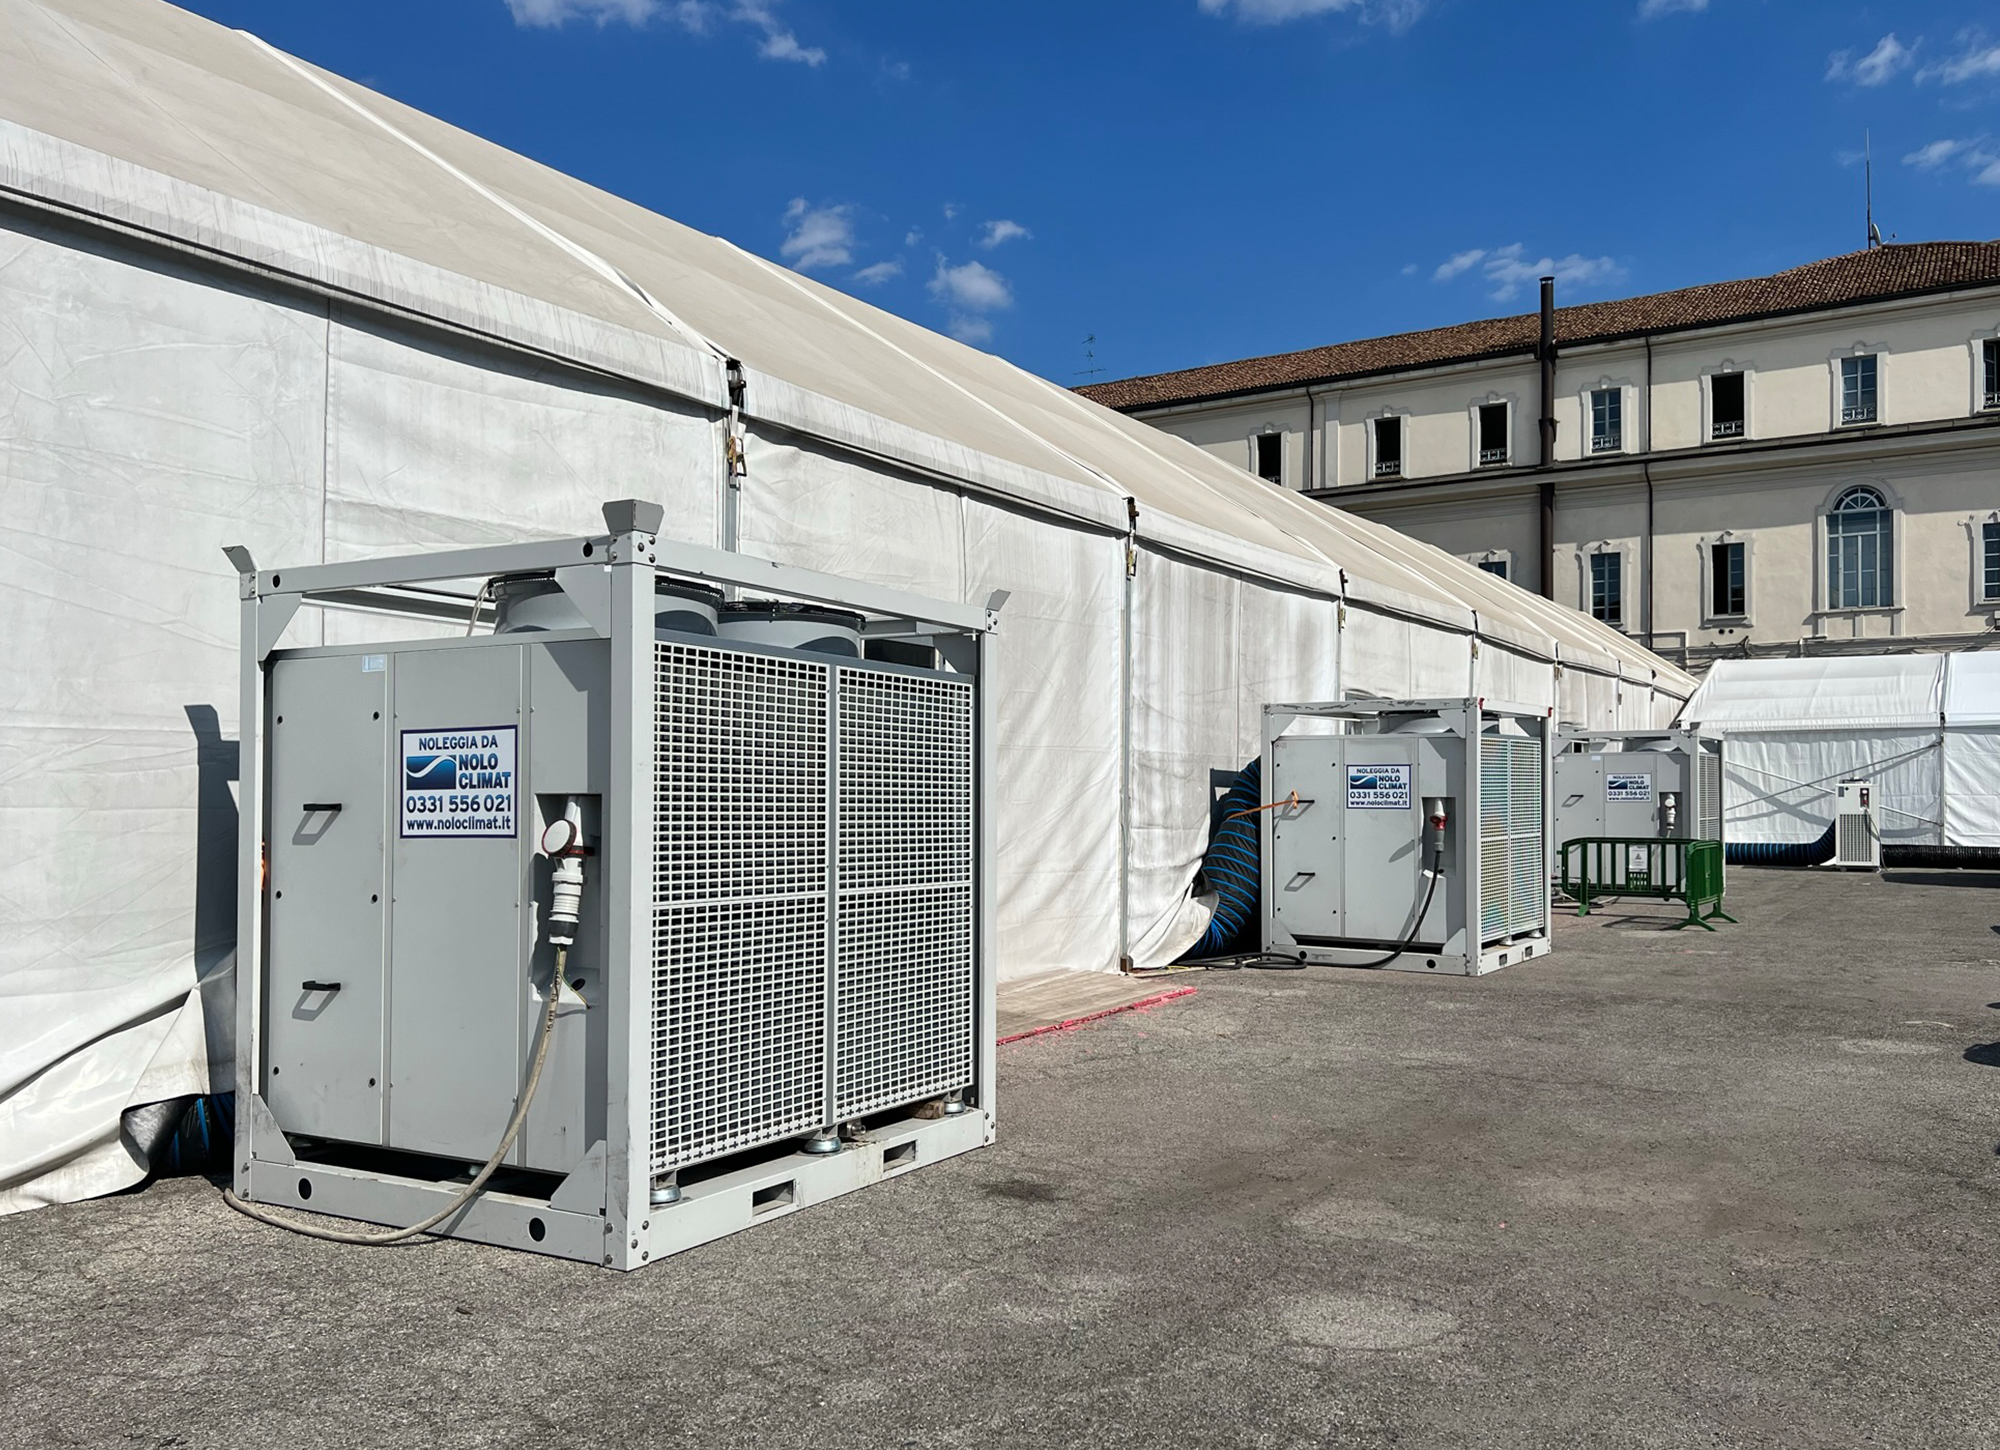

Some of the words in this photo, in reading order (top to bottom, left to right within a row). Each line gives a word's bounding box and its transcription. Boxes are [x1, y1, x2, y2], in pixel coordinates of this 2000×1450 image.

[419, 736, 478, 751] NOLEGGIA
[481, 735, 498, 748] DA
[459, 753, 498, 770] NOLO
[458, 772, 511, 789] CLIMAT
[1350, 791, 1371, 799] 0331
[1373, 791, 1391, 799] 556
[1392, 791, 1408, 799] 021
[406, 795, 443, 813] 0331
[449, 795, 480, 812] 556
[484, 794, 511, 812] 021
[407, 815, 511, 830] www.noloclimat.it
